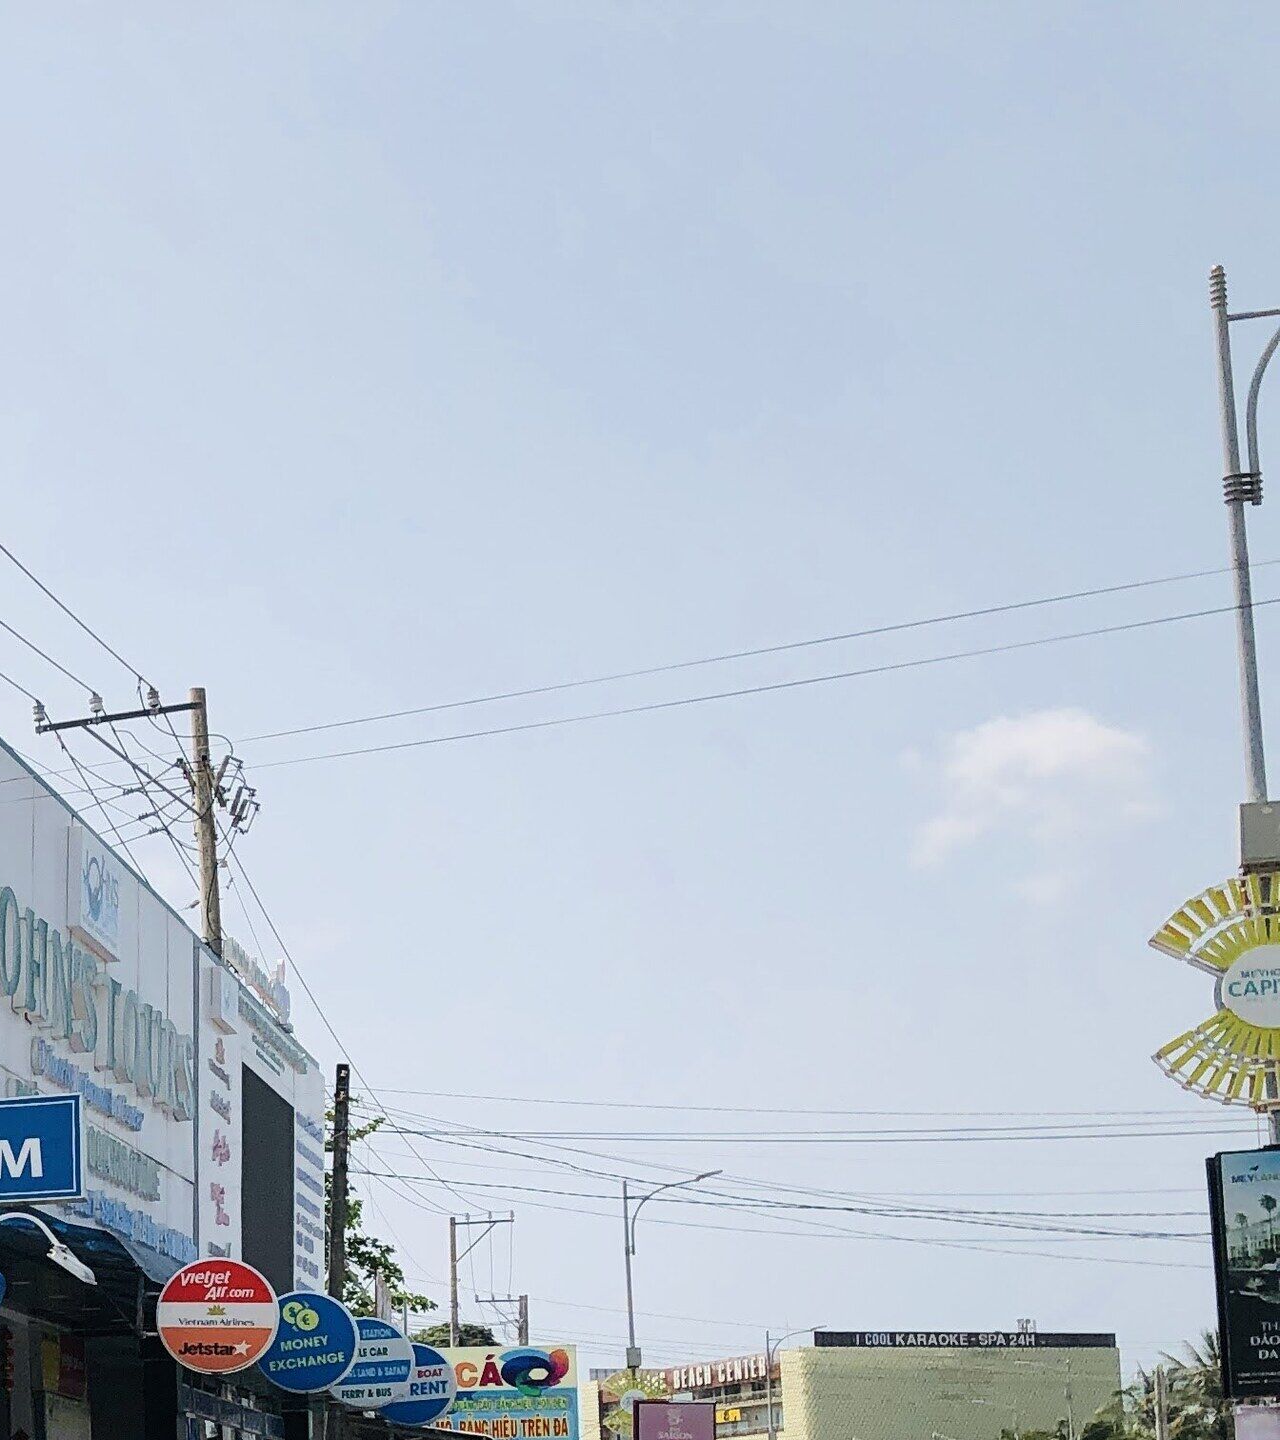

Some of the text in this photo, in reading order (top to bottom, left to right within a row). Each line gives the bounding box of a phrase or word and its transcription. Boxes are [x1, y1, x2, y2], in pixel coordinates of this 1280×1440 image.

[1228, 979, 1280, 997] CAPI
[178, 1318, 255, 1327] Vietnam Airlines
[280, 1335, 328, 1352] MONEY
[865, 1333, 893, 1346] COOL
[895, 1333, 969, 1346] KARAOKE
[978, 1333, 1006, 1346] SPA
[1009, 1334, 1036, 1346] 24H
[178, 1341, 237, 1357] Jetstar
[369, 1347, 388, 1357] CAR
[269, 1352, 345, 1371] EXCHANGE
[417, 1369, 443, 1378] BOAT
[673, 1364, 712, 1389] BEACH
[717, 1356, 768, 1383] CENTER
[341, 1388, 365, 1398] FERRY
[376, 1388, 392, 1397] BUS
[410, 1381, 448, 1396] RENT
[521, 1414, 550, 1437] TRÊN
[554, 1411, 568, 1436] ĐÁ
